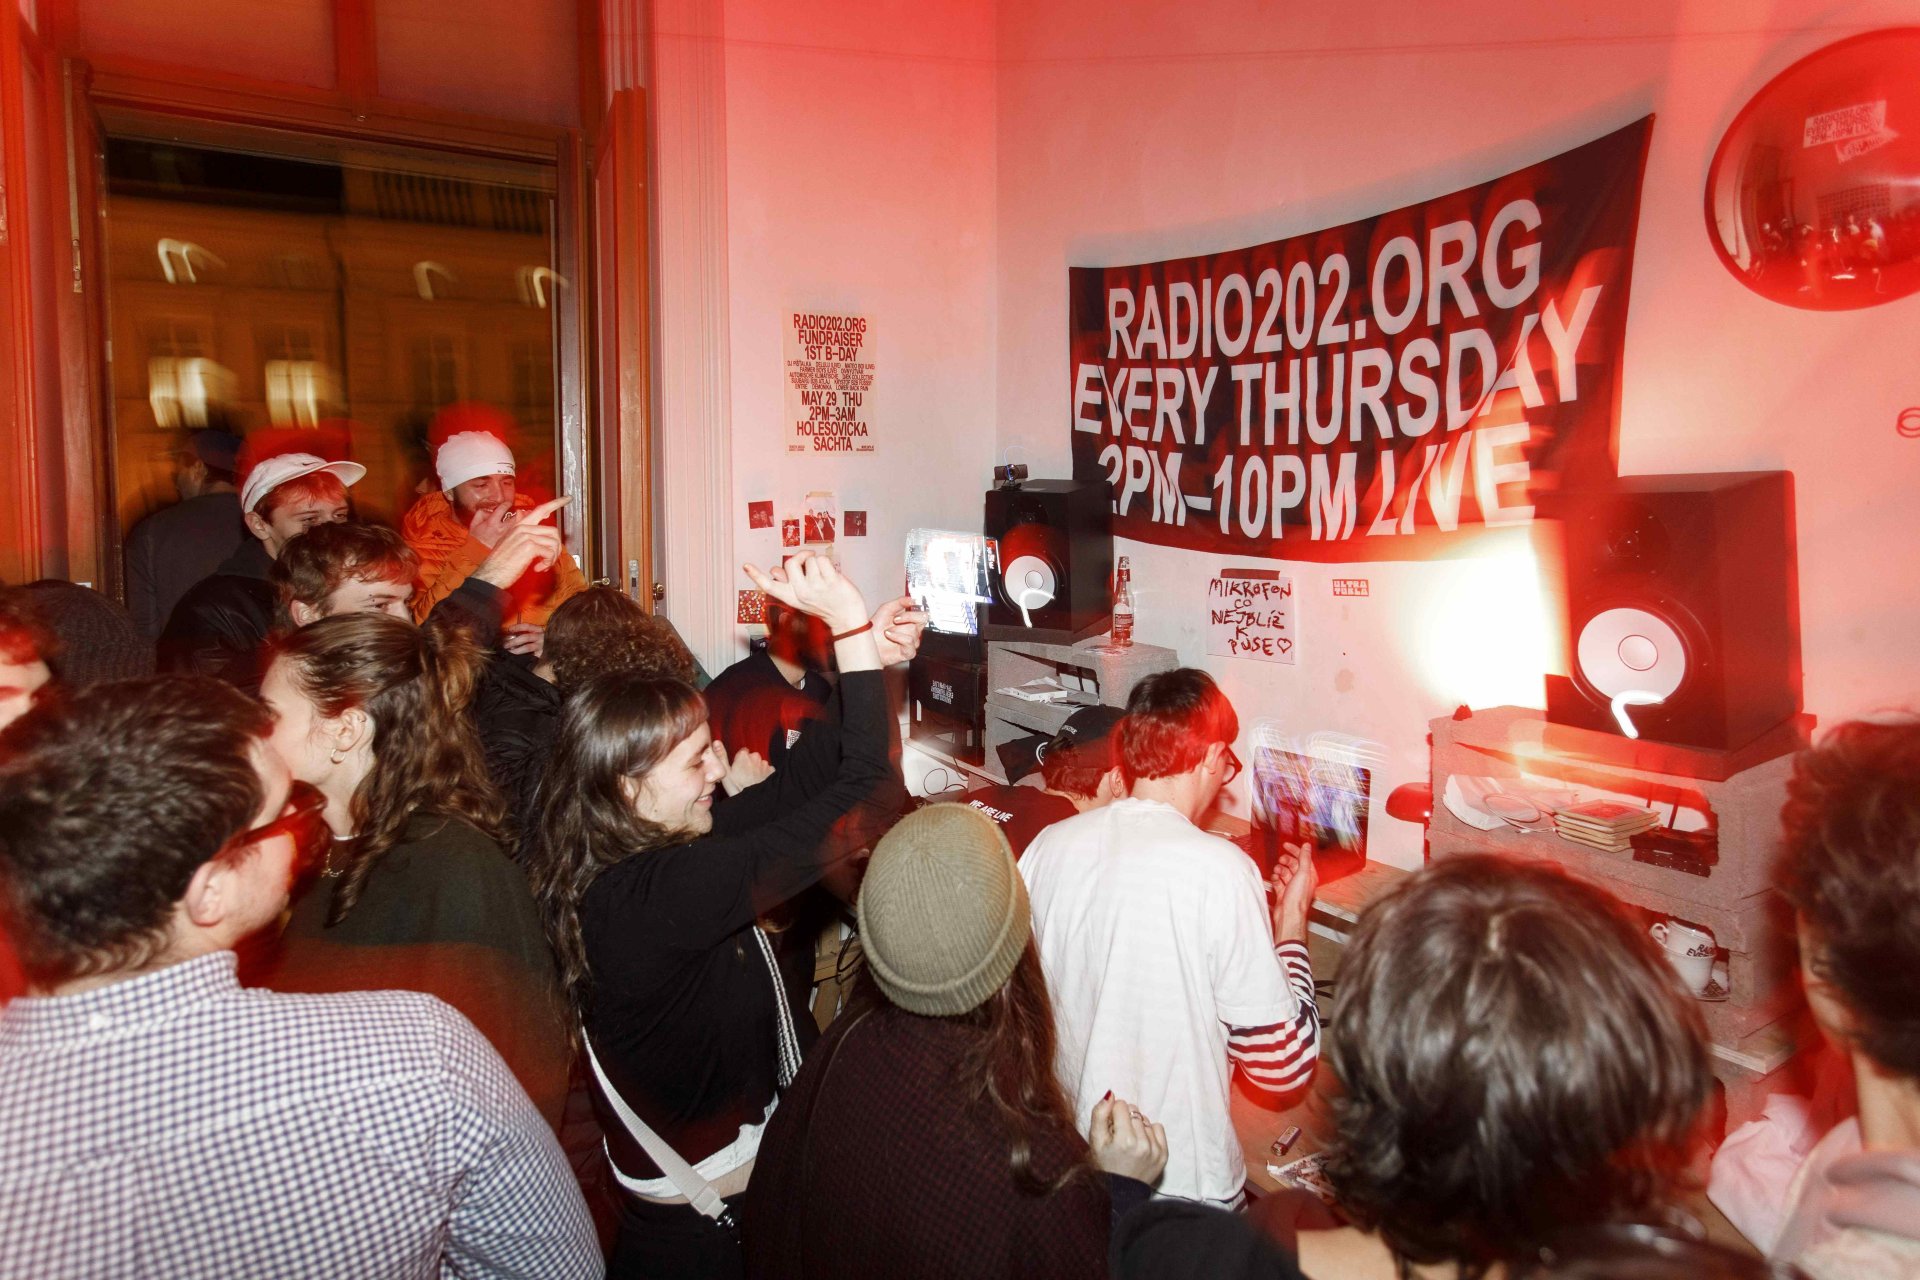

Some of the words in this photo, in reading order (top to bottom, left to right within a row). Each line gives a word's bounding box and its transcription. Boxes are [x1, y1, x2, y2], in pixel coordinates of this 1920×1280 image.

[1108, 198, 1543, 361] RADIO202.ORG
[794, 313, 867, 332] RADIO202.ORG
[798, 329, 863, 347] FUNDRAISER
[804, 346, 822, 360] 1ST
[826, 346, 858, 362] B-DAY
[1074, 363, 1217, 445] EVERY
[1231, 286, 1605, 446] THURSDAY
[802, 391, 823, 405] MAY
[826, 392, 837, 406] 29
[842, 392, 862, 406] THU
[797, 421, 868, 436] HOLESOVICKA
[814, 437, 853, 451] SACHTA
[1367, 422, 1536, 537] LIVE
[1209, 578, 1292, 600] MIKROFON
[1234, 599, 1253, 610] CO
[1236, 626, 1249, 640] K
[968, 799, 984, 809] WE
[980, 805, 998, 817] ARE
[993, 811, 1014, 822] LIVE
